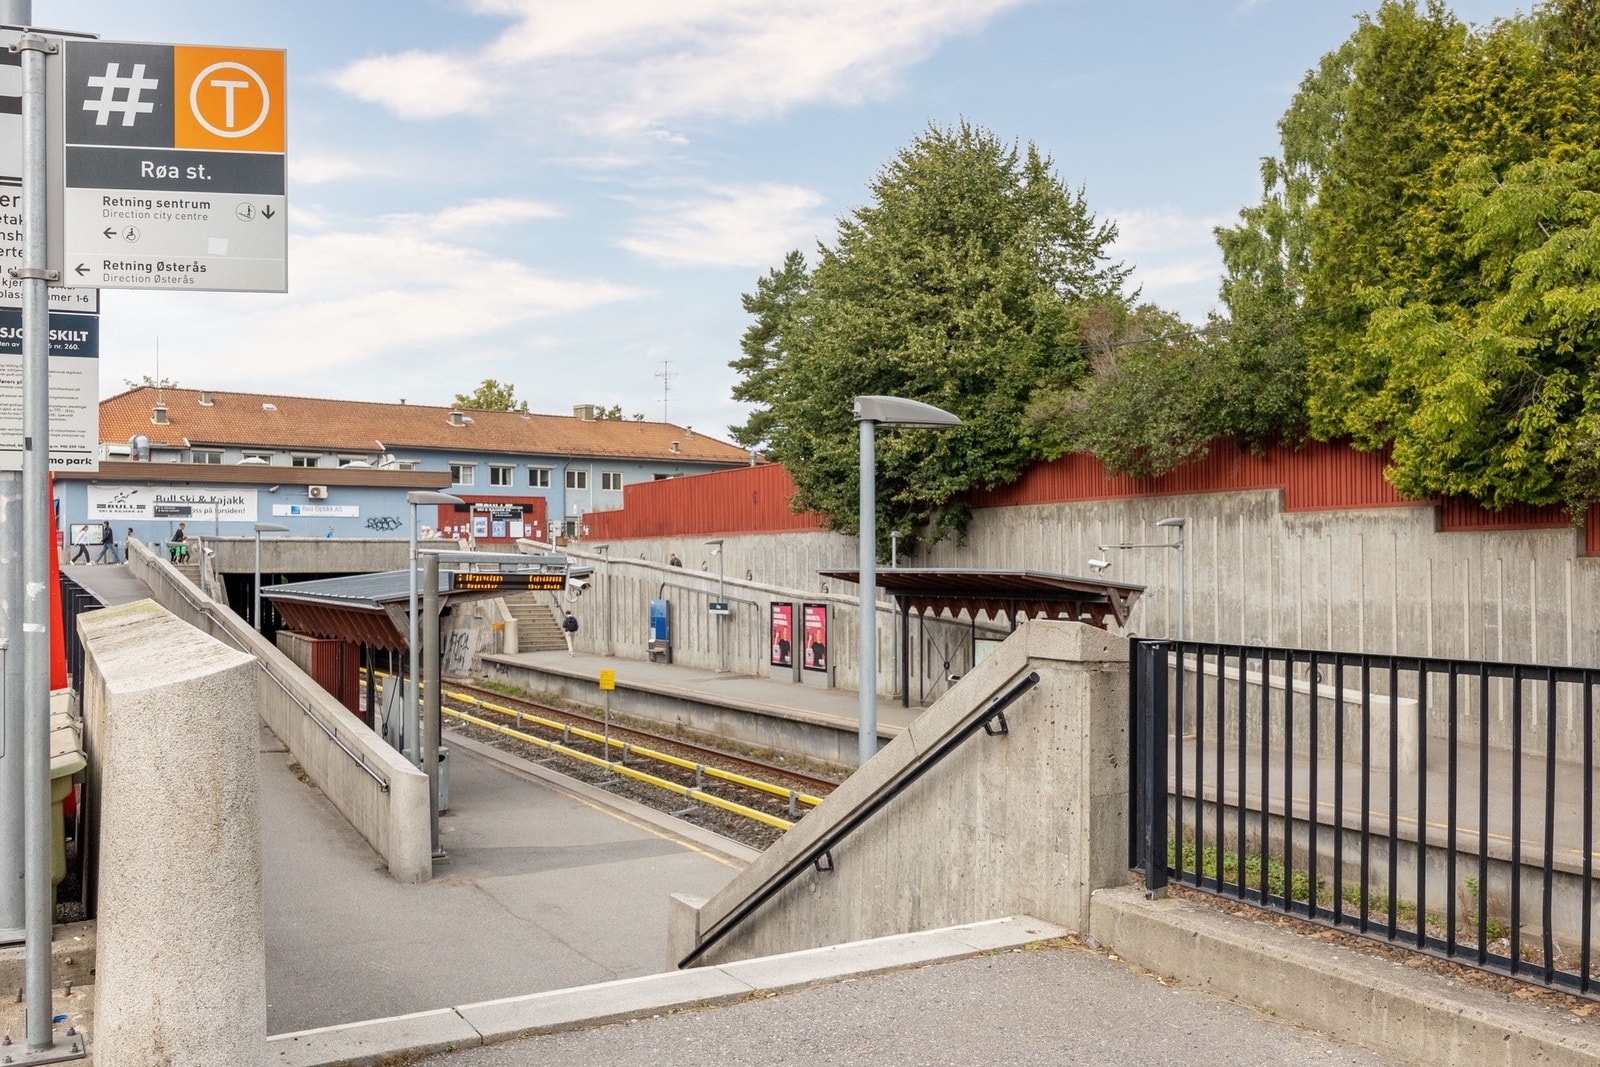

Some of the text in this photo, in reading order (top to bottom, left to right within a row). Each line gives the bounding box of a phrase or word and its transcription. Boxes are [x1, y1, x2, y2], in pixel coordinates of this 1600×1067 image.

[141, 161, 212, 180] Røa st.
[102, 196, 211, 210] Retning sentrum
[102, 209, 209, 221] Direction city centre
[103, 260, 207, 273] Retning Østerås
[103, 273, 195, 284] Direction Østerås
[66, 457, 92, 466] park
[156, 494, 176, 503] Bull
[179, 495, 195, 503] Ski
[210, 496, 245, 507] Kajakk
